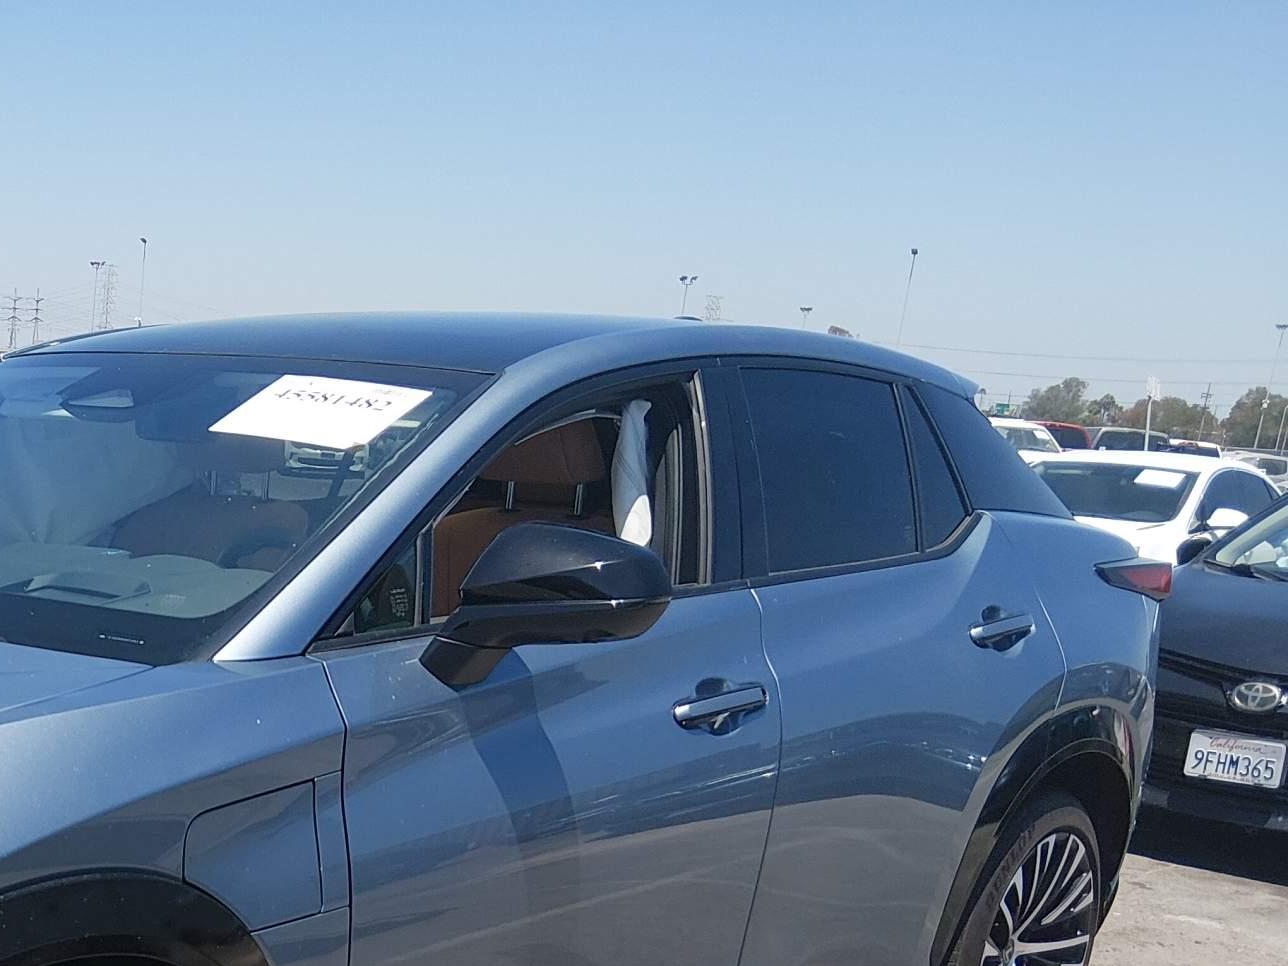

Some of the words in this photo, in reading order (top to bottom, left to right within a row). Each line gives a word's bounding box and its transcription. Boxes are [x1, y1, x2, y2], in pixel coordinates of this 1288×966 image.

[274, 388, 393, 411] 45581482
[1209, 736, 1265, 755] California
[1191, 749, 1276, 781] 9FHM365
